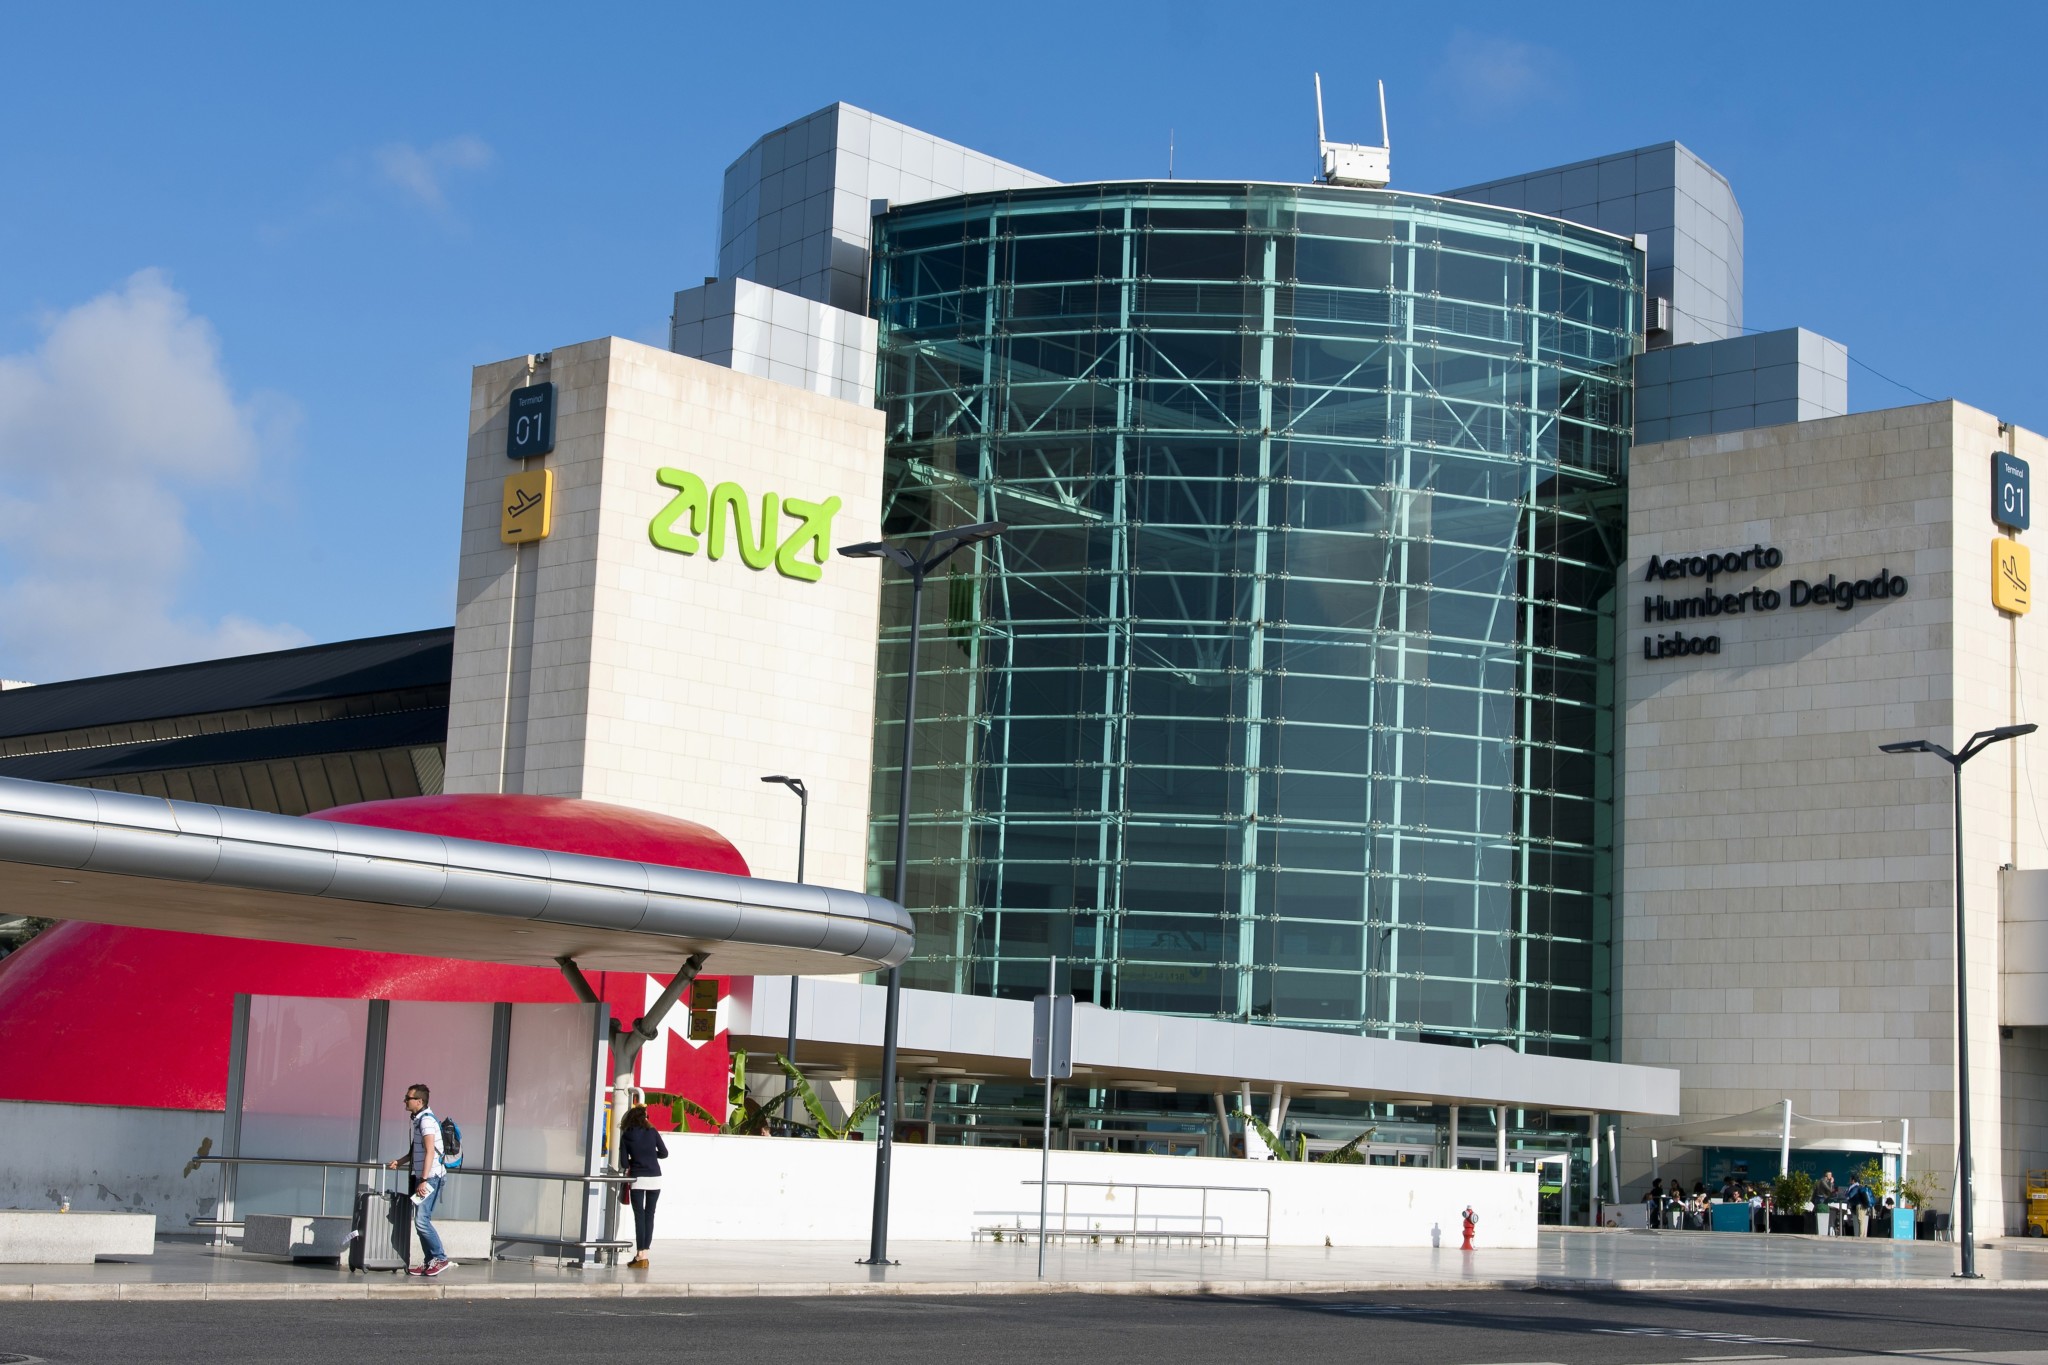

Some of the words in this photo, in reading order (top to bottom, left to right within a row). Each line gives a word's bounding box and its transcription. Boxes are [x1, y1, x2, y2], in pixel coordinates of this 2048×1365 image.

[518, 393, 544, 407] Terminal
[516, 412, 542, 445] 01
[2004, 462, 2024, 478] Terminal
[2004, 482, 2024, 517] 01
[1645, 543, 1783, 583] Aeroporto
[1644, 586, 1781, 622] Humberto
[1790, 568, 1909, 611] Delgado
[1644, 631, 1721, 660] Lisboa
